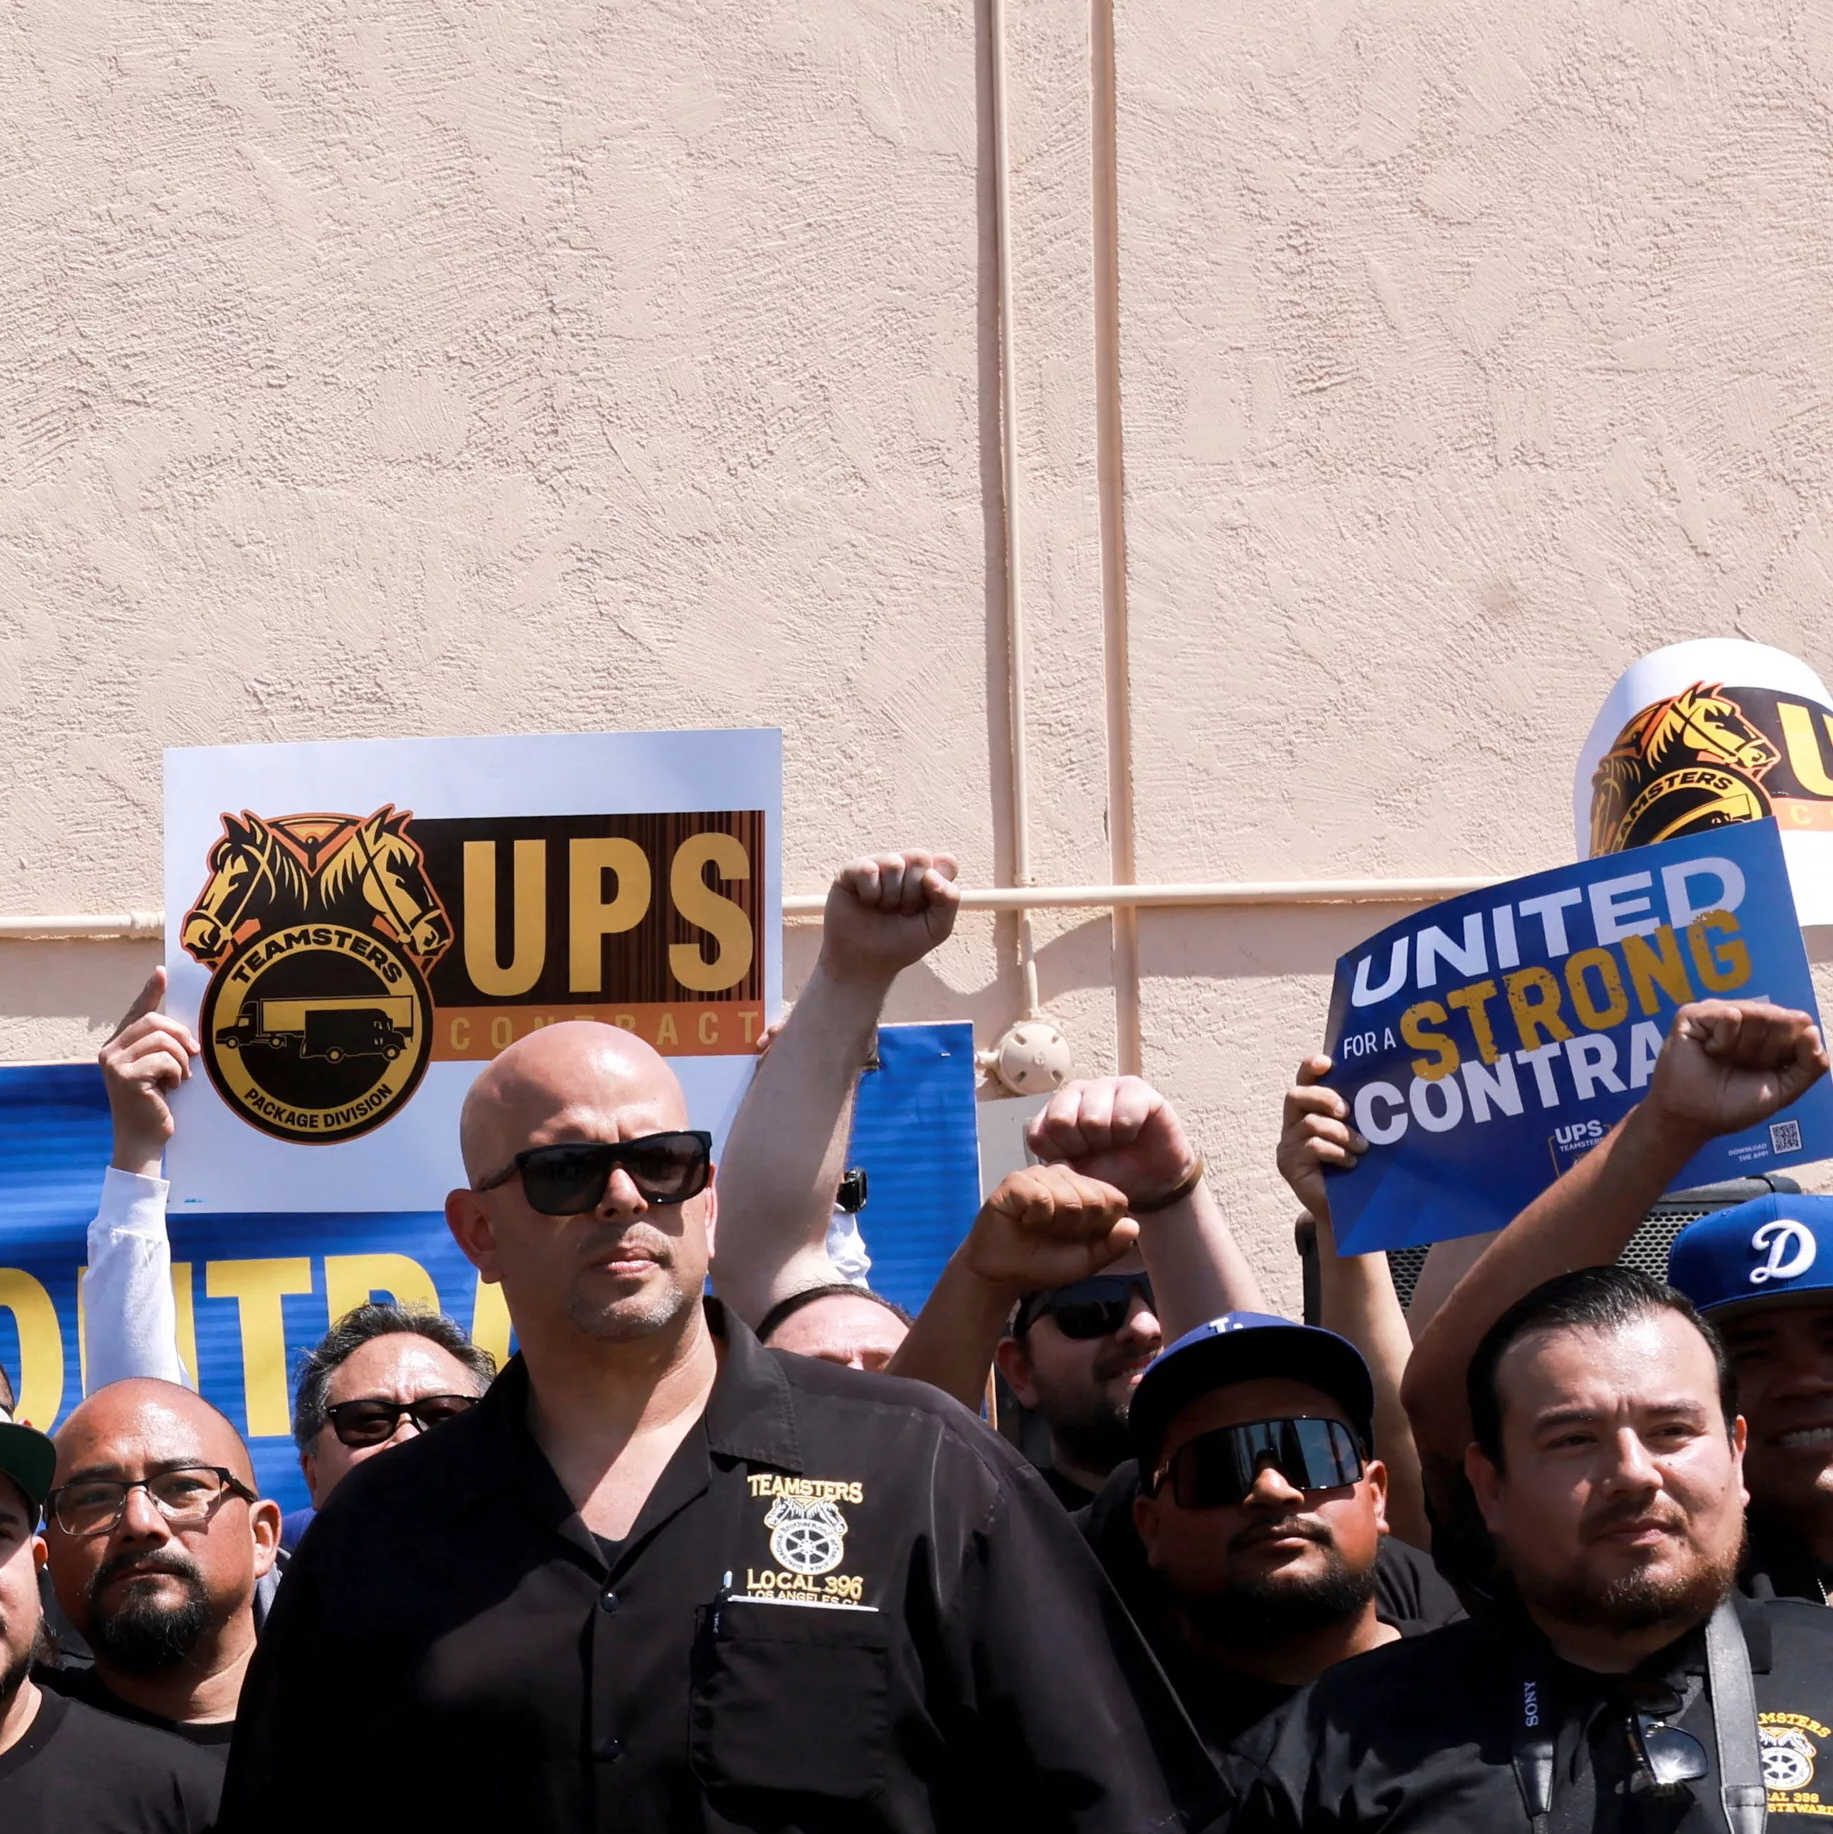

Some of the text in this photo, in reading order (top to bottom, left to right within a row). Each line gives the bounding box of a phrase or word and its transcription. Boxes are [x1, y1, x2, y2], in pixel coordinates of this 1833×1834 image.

[462, 831, 754, 997] UPS
[1351, 858, 1746, 1008] UNITED
[231, 928, 403, 984] TEAMSTERS
[1343, 909, 1751, 1081] FOR A STRONG
[450, 1012, 758, 1050] COACT
[1354, 1000, 1770, 1145] CONTRA
[245, 1083, 393, 1129] PACKAGE DIVISION
[1555, 1119, 1602, 1145] UPS
[1728, 1143, 1767, 1157] DOWNLOAD
[1750, 1220, 1817, 1284] D
[747, 1474, 863, 1504] TEAMSTERS
[747, 1569, 863, 1600] LOCAL 396
[1523, 1681, 1539, 1727] SONY
